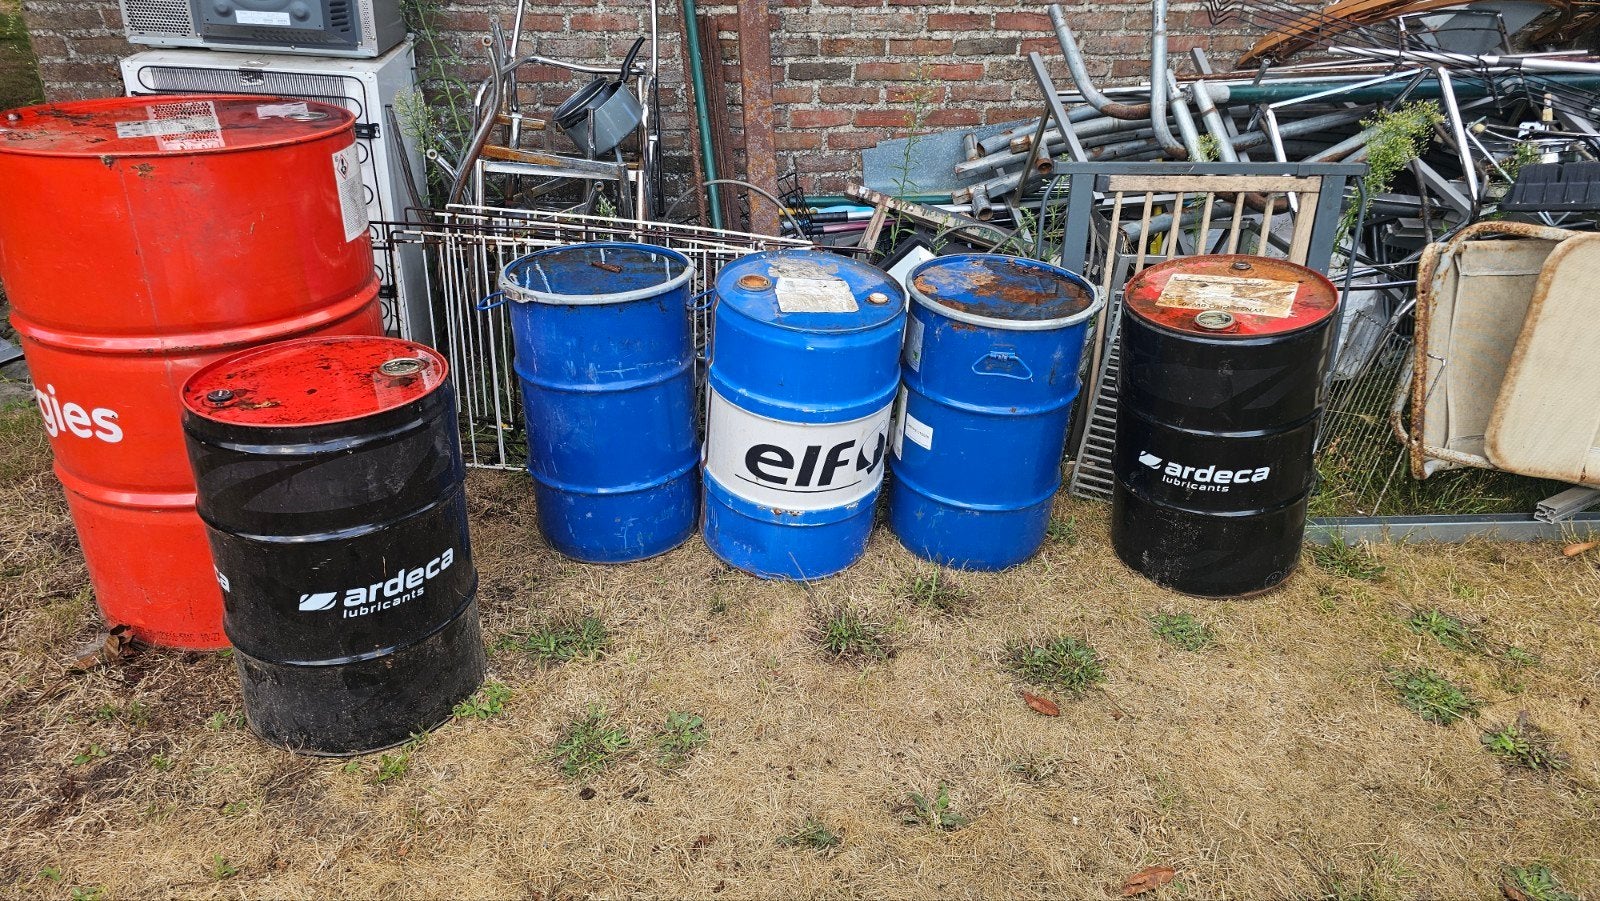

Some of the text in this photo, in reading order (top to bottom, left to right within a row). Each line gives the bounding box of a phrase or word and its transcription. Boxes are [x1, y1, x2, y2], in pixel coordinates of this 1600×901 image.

[36, 383, 124, 443] gies
[745, 439, 856, 487] elf
[1164, 461, 1271, 484] ardeca
[1162, 474, 1230, 493] lubricants
[343, 547, 454, 608] ardeca
[343, 586, 425, 619] lubricants
